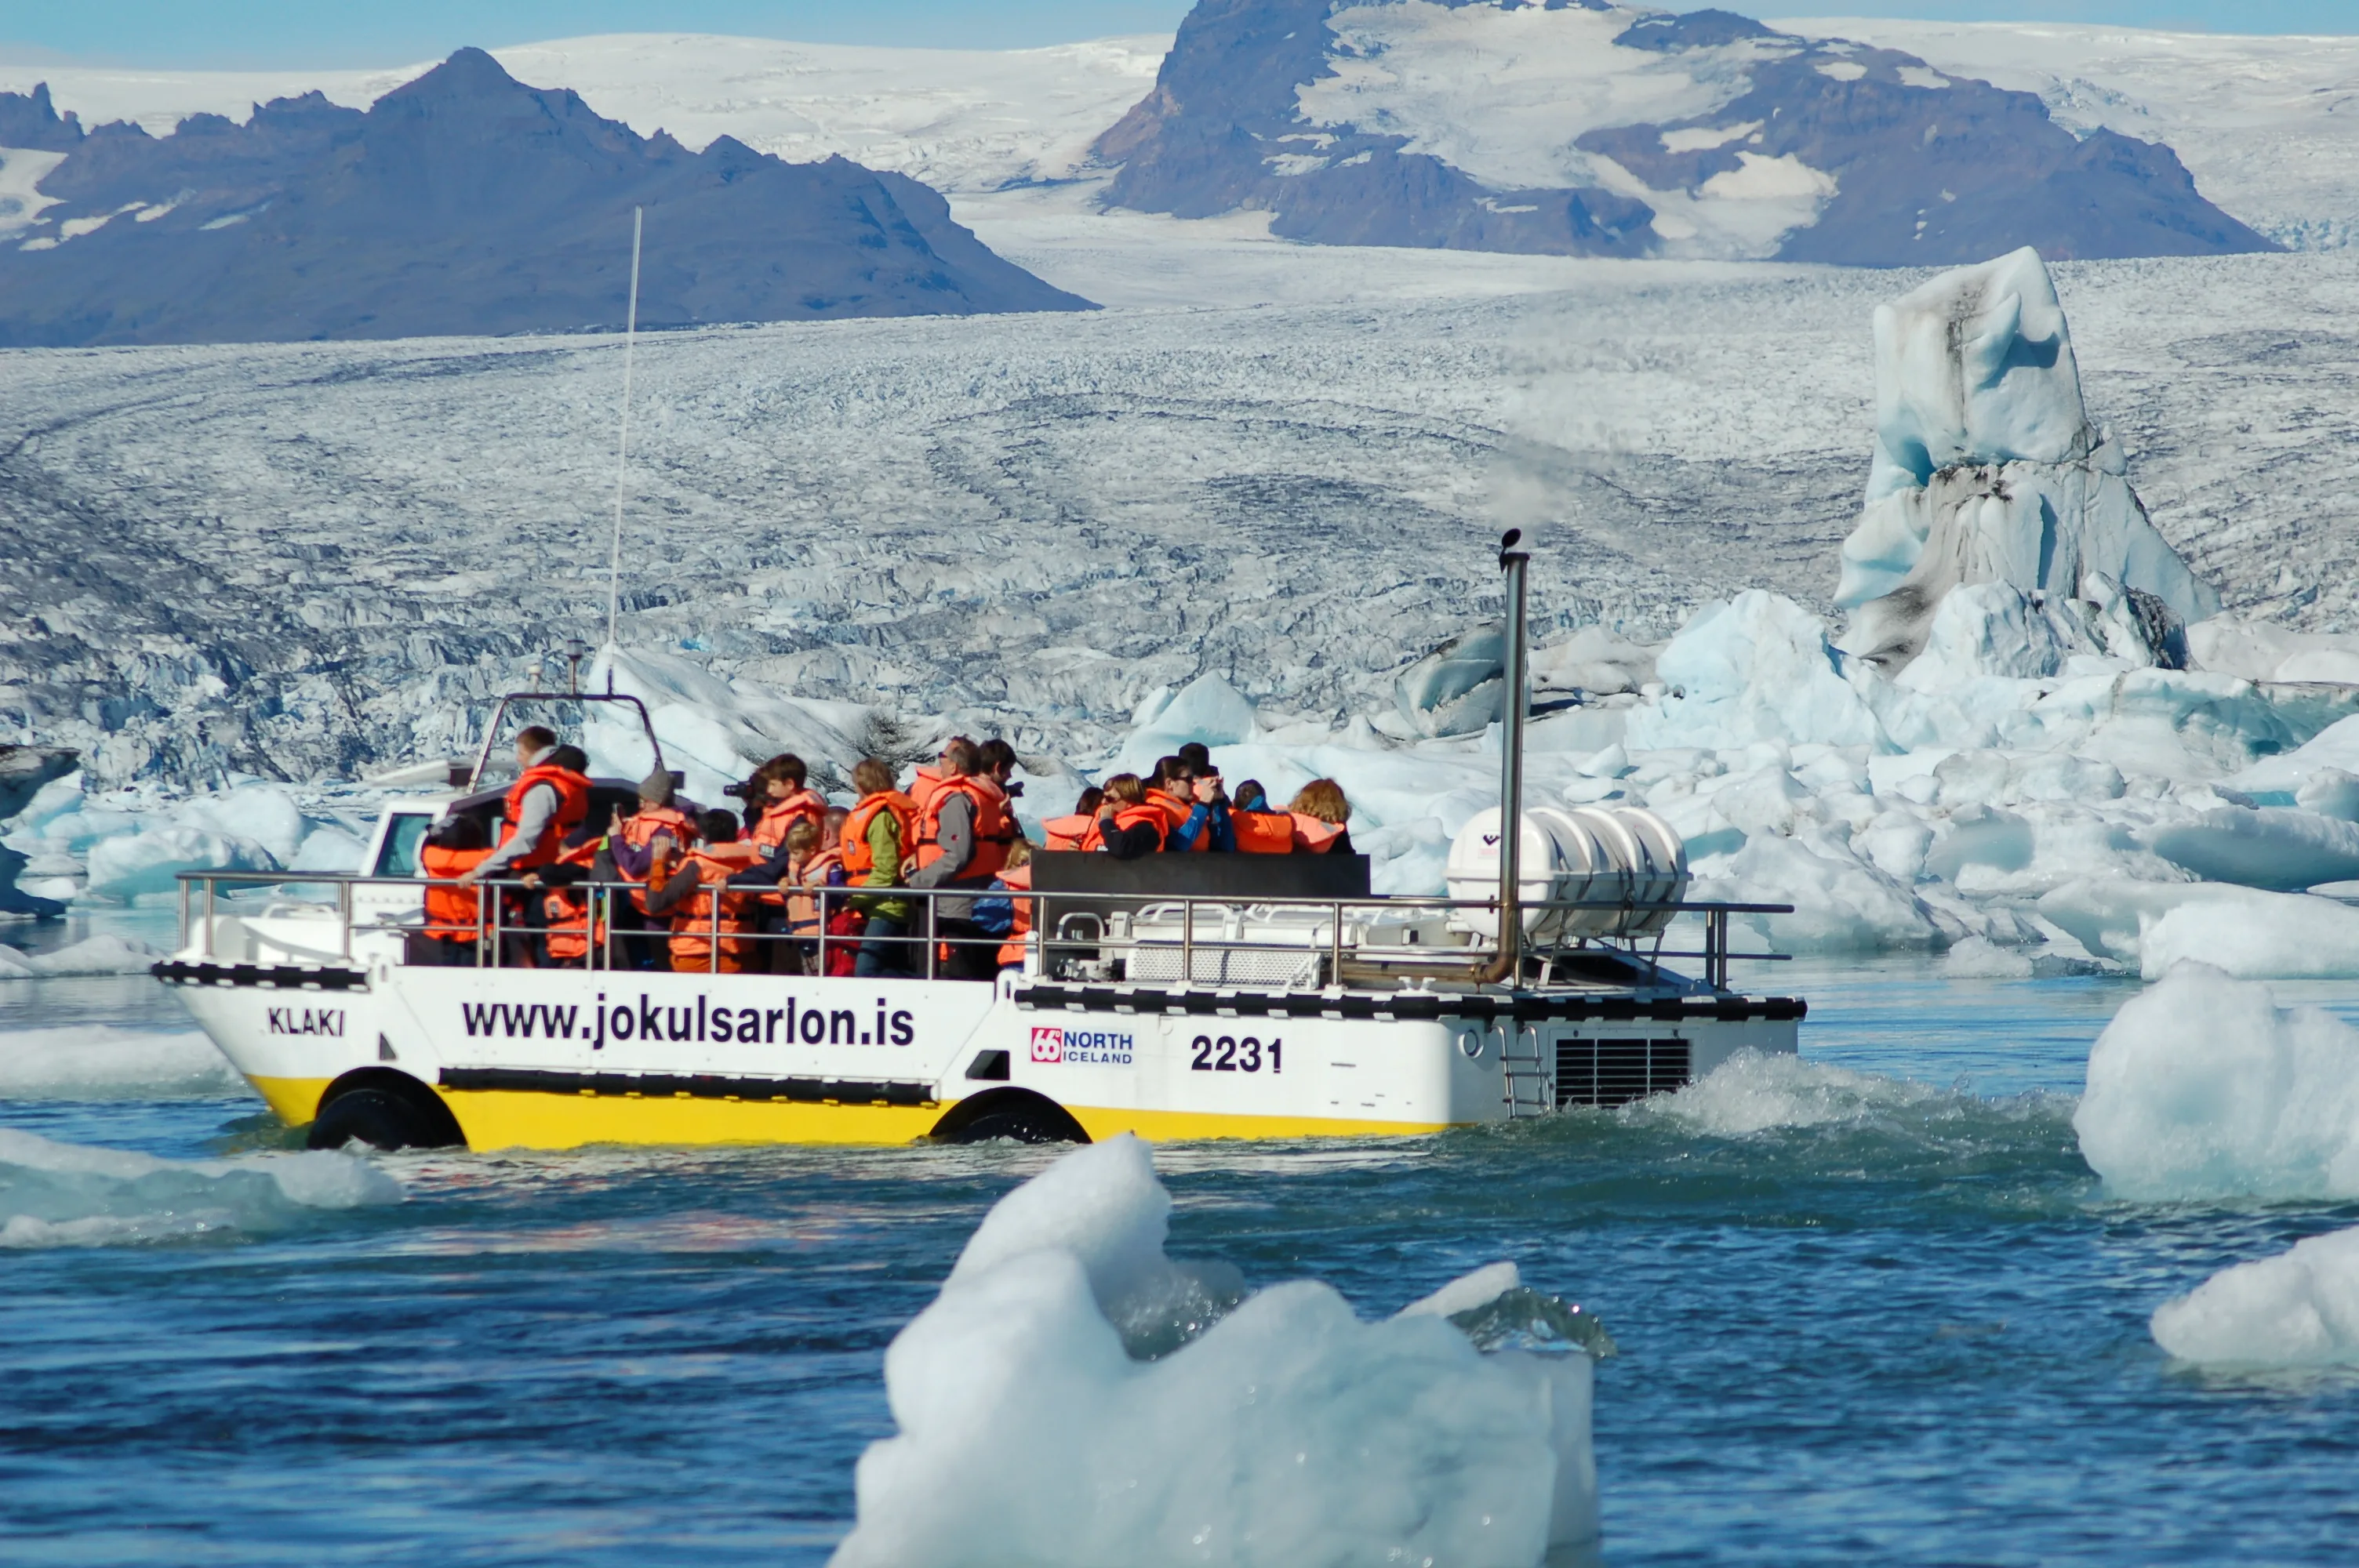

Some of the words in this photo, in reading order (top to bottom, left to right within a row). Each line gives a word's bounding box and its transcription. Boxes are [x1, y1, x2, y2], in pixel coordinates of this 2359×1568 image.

[268, 1007, 344, 1036] KLAKI
[462, 993, 914, 1050] www.jokulsarlon.is
[1063, 1031, 1133, 1051] NORTH
[1190, 1035, 1281, 1073] 2231
[1063, 1051, 1132, 1064] ICELAND
